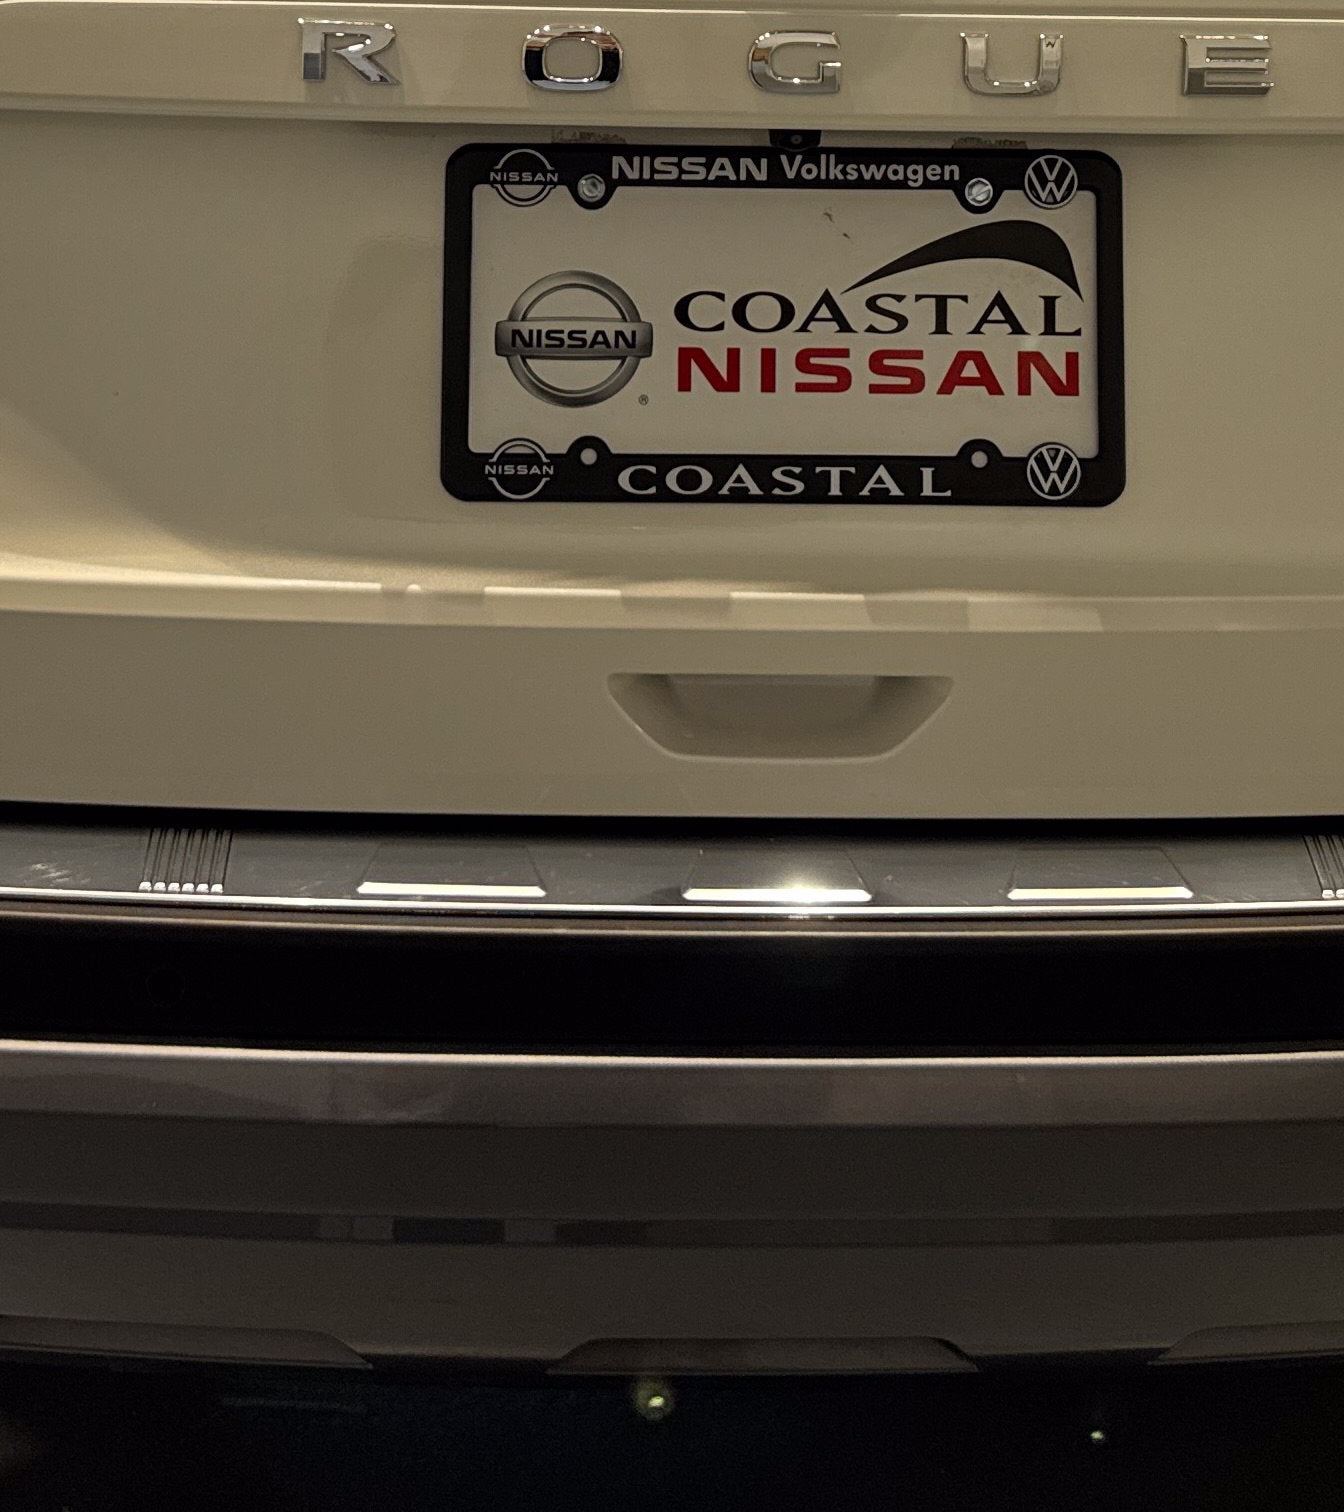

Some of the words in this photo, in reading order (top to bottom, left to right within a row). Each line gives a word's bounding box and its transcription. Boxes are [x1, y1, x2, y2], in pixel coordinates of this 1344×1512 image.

[298, 18, 1274, 97] ROGUE
[490, 171, 559, 183] NISSAN
[611, 155, 768, 181] NISSAN
[780, 154, 960, 187] Volkswagen
[674, 288, 1083, 337] COASTAL
[511, 329, 637, 349] NISSAN
[677, 346, 1080, 397] NISSAN
[484, 464, 554, 475] NISSAN
[617, 463, 952, 497] COASTAL
